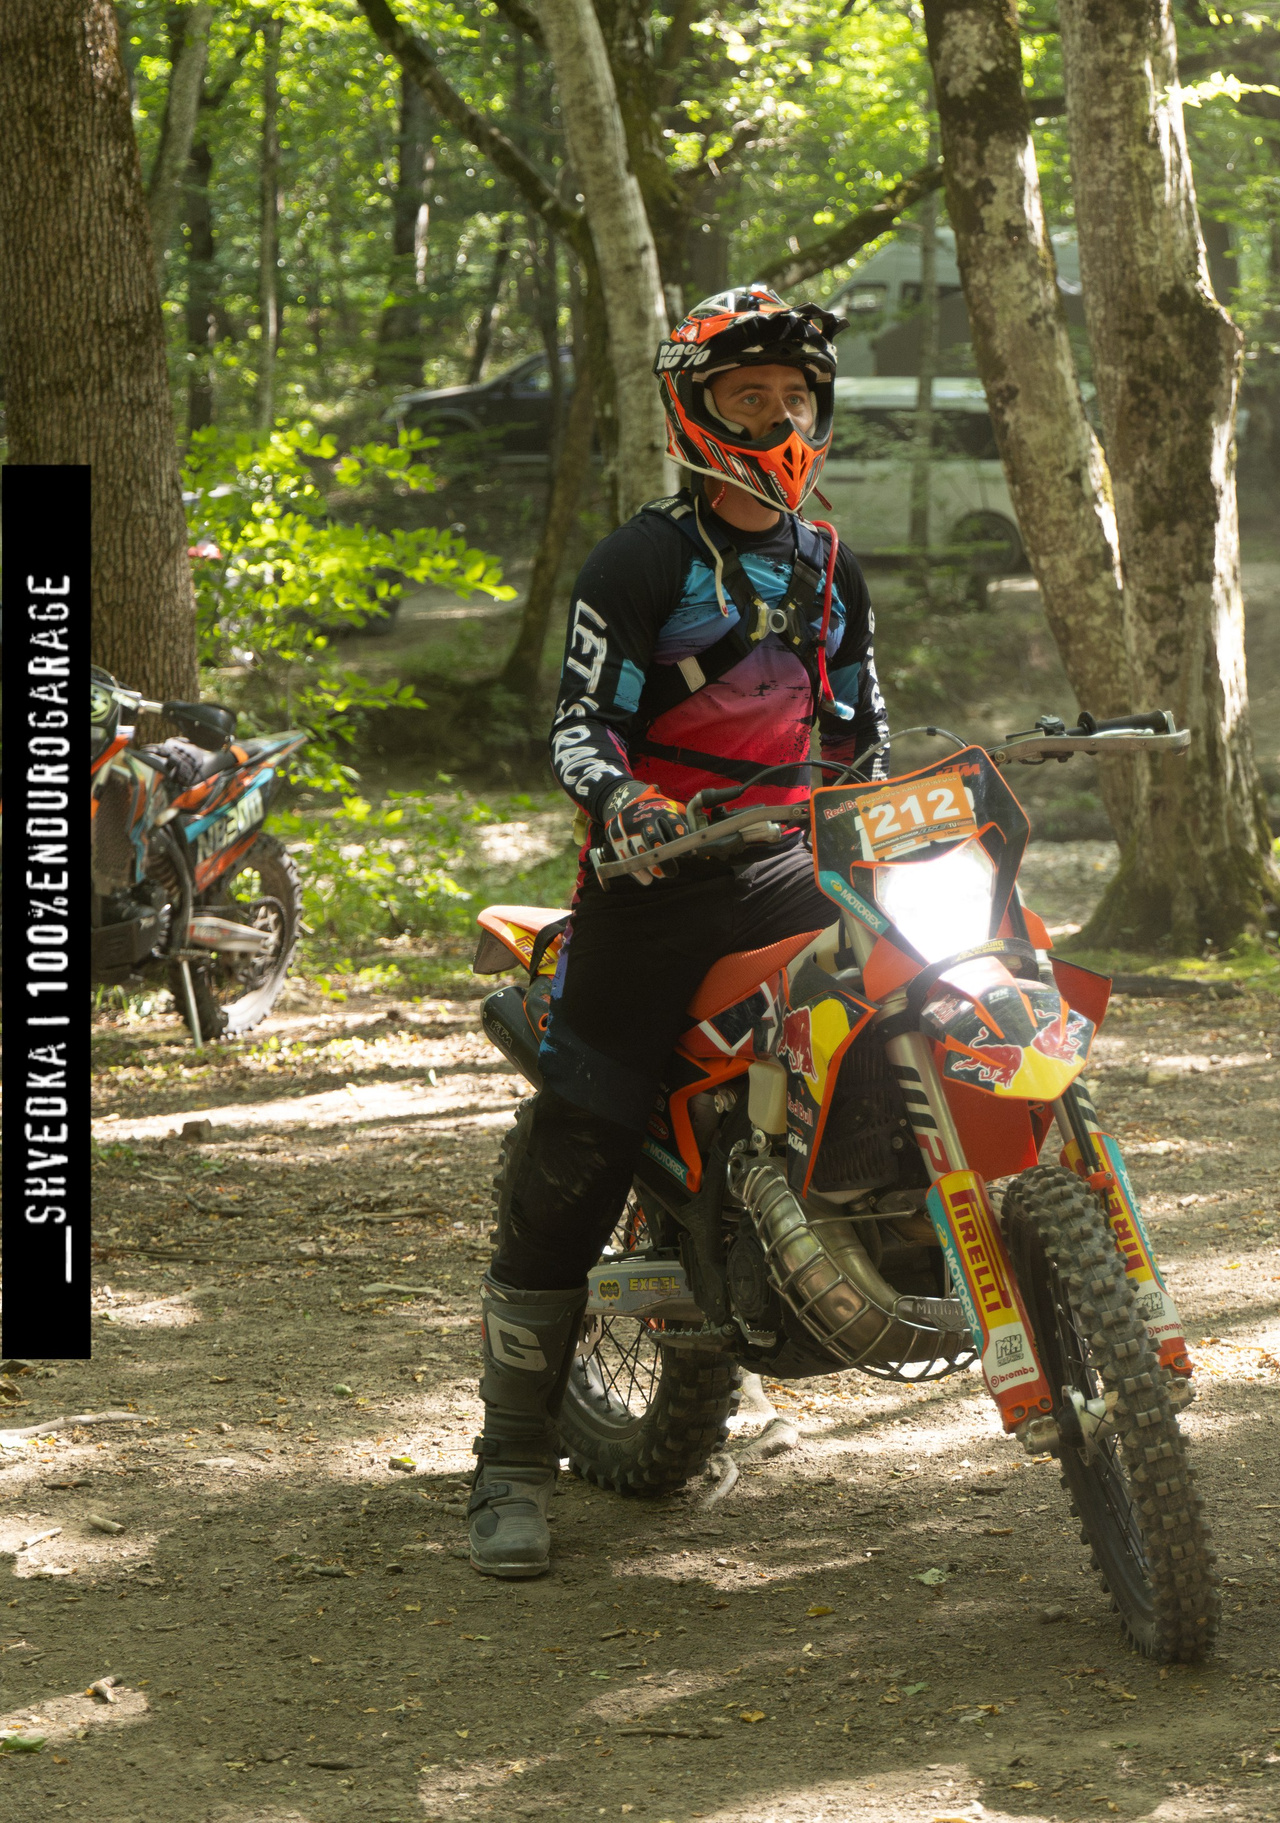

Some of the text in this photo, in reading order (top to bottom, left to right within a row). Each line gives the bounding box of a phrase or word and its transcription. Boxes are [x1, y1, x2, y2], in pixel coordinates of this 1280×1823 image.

[768, 469, 789, 499] Airoh
[552, 599, 623, 796] LET'S RACE
[823, 803, 846, 820] Red
[868, 788, 960, 838] 212
[841, 889, 881, 929] MOTOREX
[799, 1099, 814, 1127] Bull
[787, 1132, 808, 1156] KTM
[649, 1143, 685, 1179] MOTOREX
[949, 1189, 1012, 1313] PIRELLI
[629, 1277, 680, 1291] EXCEL
[945, 1247, 981, 1336] MOTOREX
[999, 1366, 1035, 1383] brembo
